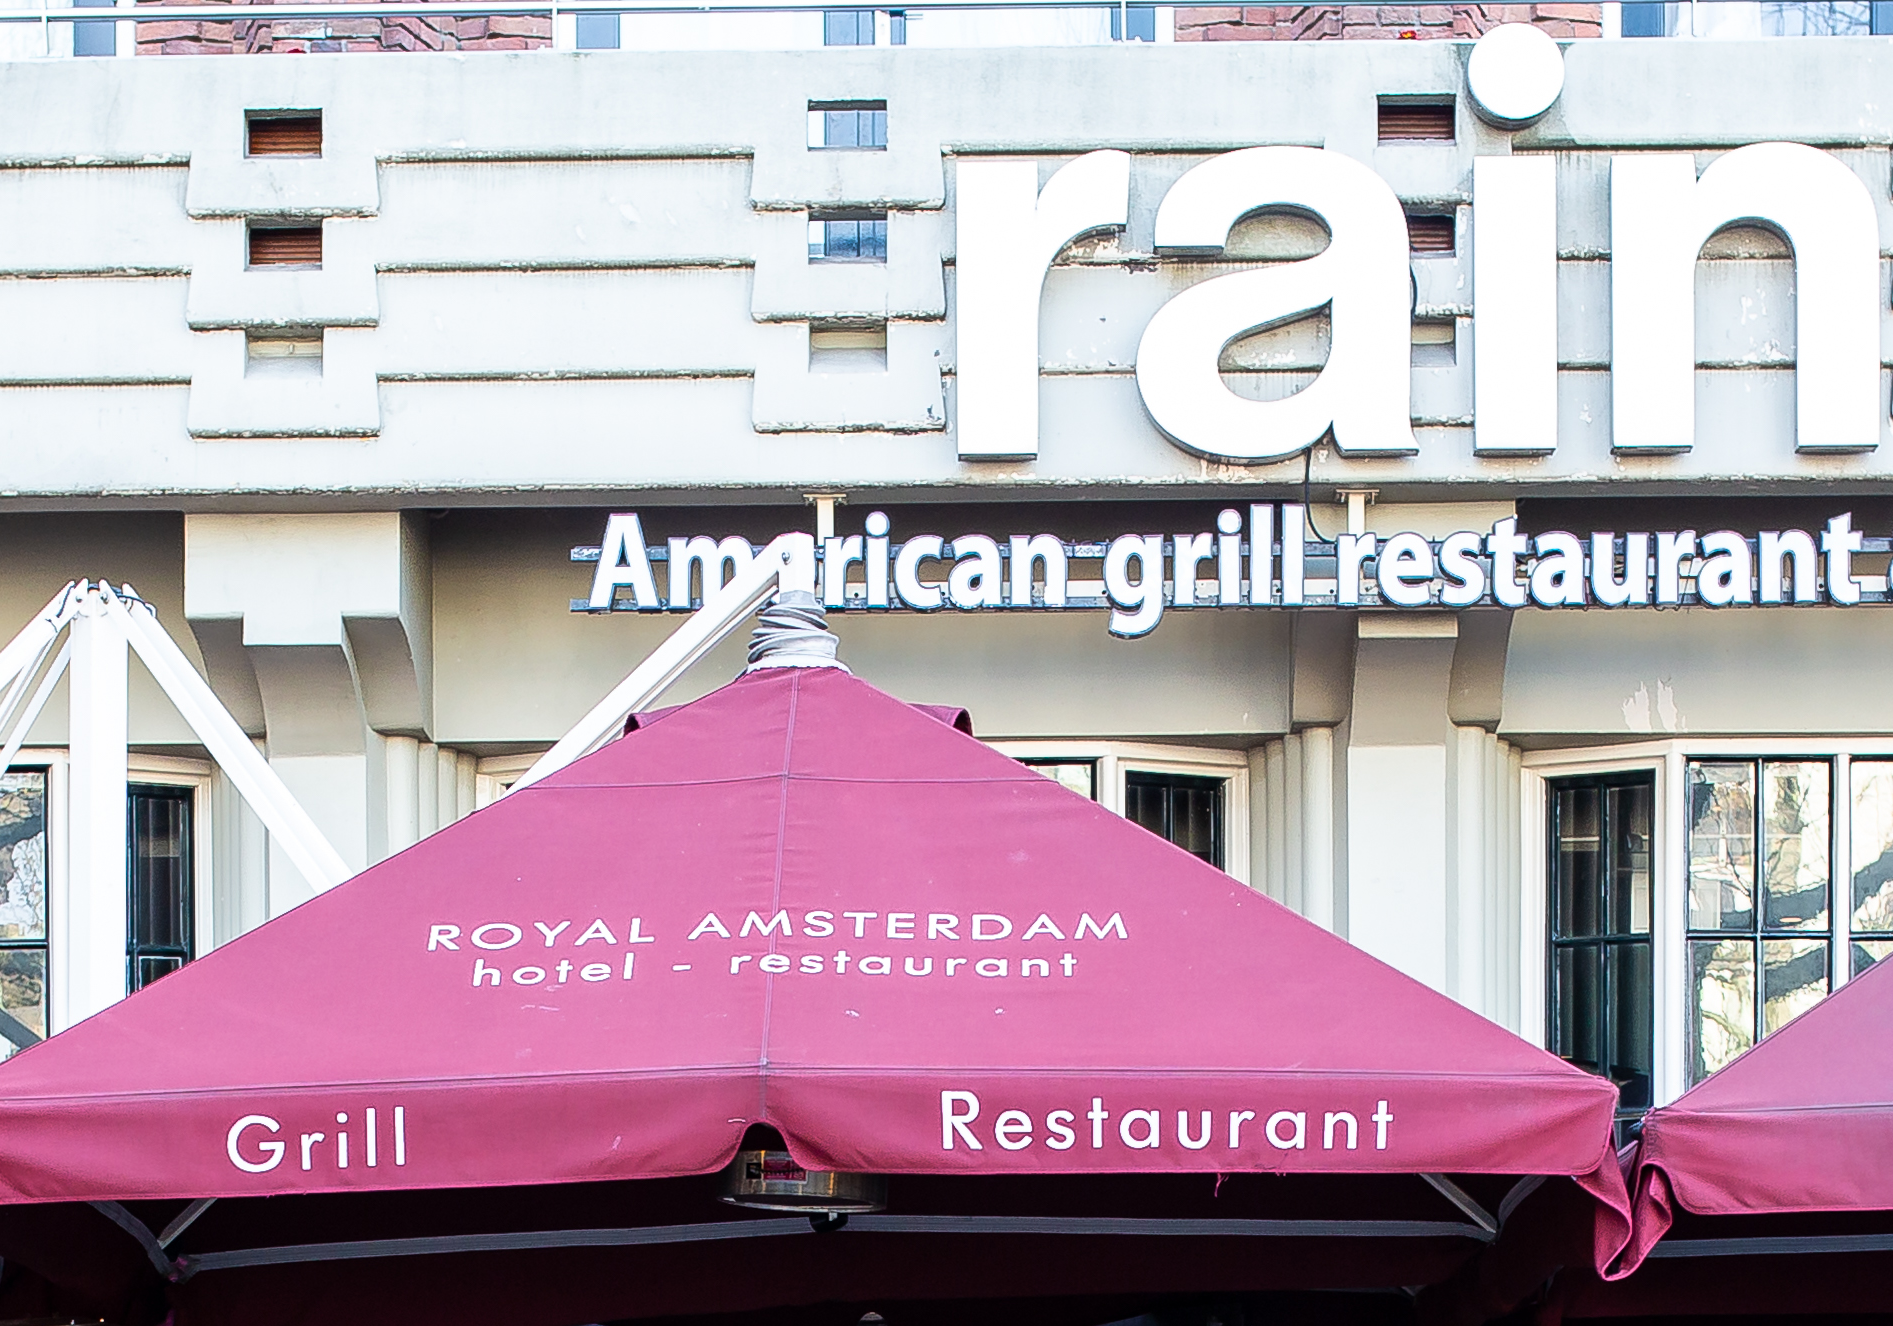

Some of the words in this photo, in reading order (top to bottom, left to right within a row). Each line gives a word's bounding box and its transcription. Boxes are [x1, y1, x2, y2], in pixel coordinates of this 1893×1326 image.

[954, 21, 1881, 466] rain
[588, 511, 1069, 612] Amrican
[1105, 502, 1307, 640] grill
[1334, 511, 1864, 608] restaurant
[426, 916, 656, 952] ROYAL
[686, 908, 1129, 941] AMSTERDAM
[471, 951, 636, 988] hotel
[729, 949, 1078, 978] restaurant
[226, 1105, 406, 1174] Grill
[940, 1089, 1395, 1151] Restaurant
